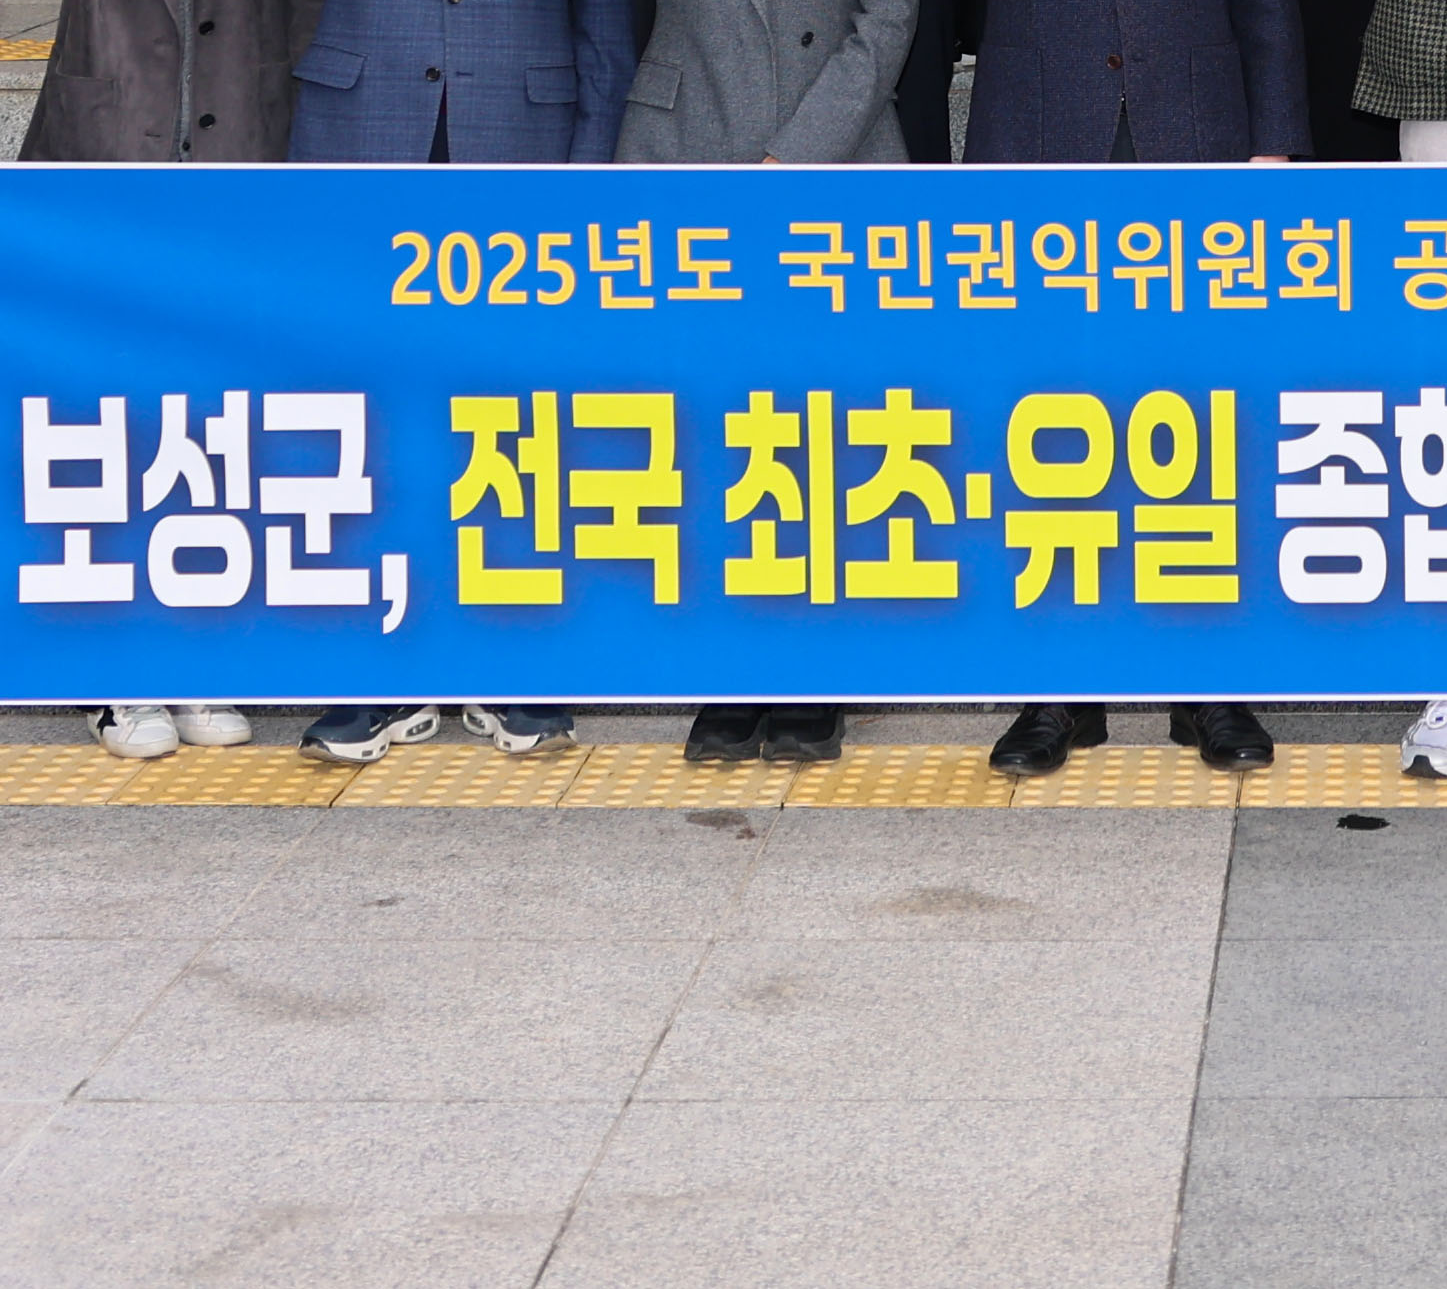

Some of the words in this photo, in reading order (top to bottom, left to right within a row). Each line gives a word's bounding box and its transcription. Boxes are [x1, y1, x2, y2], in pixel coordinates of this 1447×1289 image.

[390, 222, 745, 311] 2025년도
[778, 218, 1355, 312] 국민권익위원회
[19, 390, 407, 634] 보성군,
[449, 388, 684, 606] 전국
[722, 387, 1241, 609] 최초·유일
